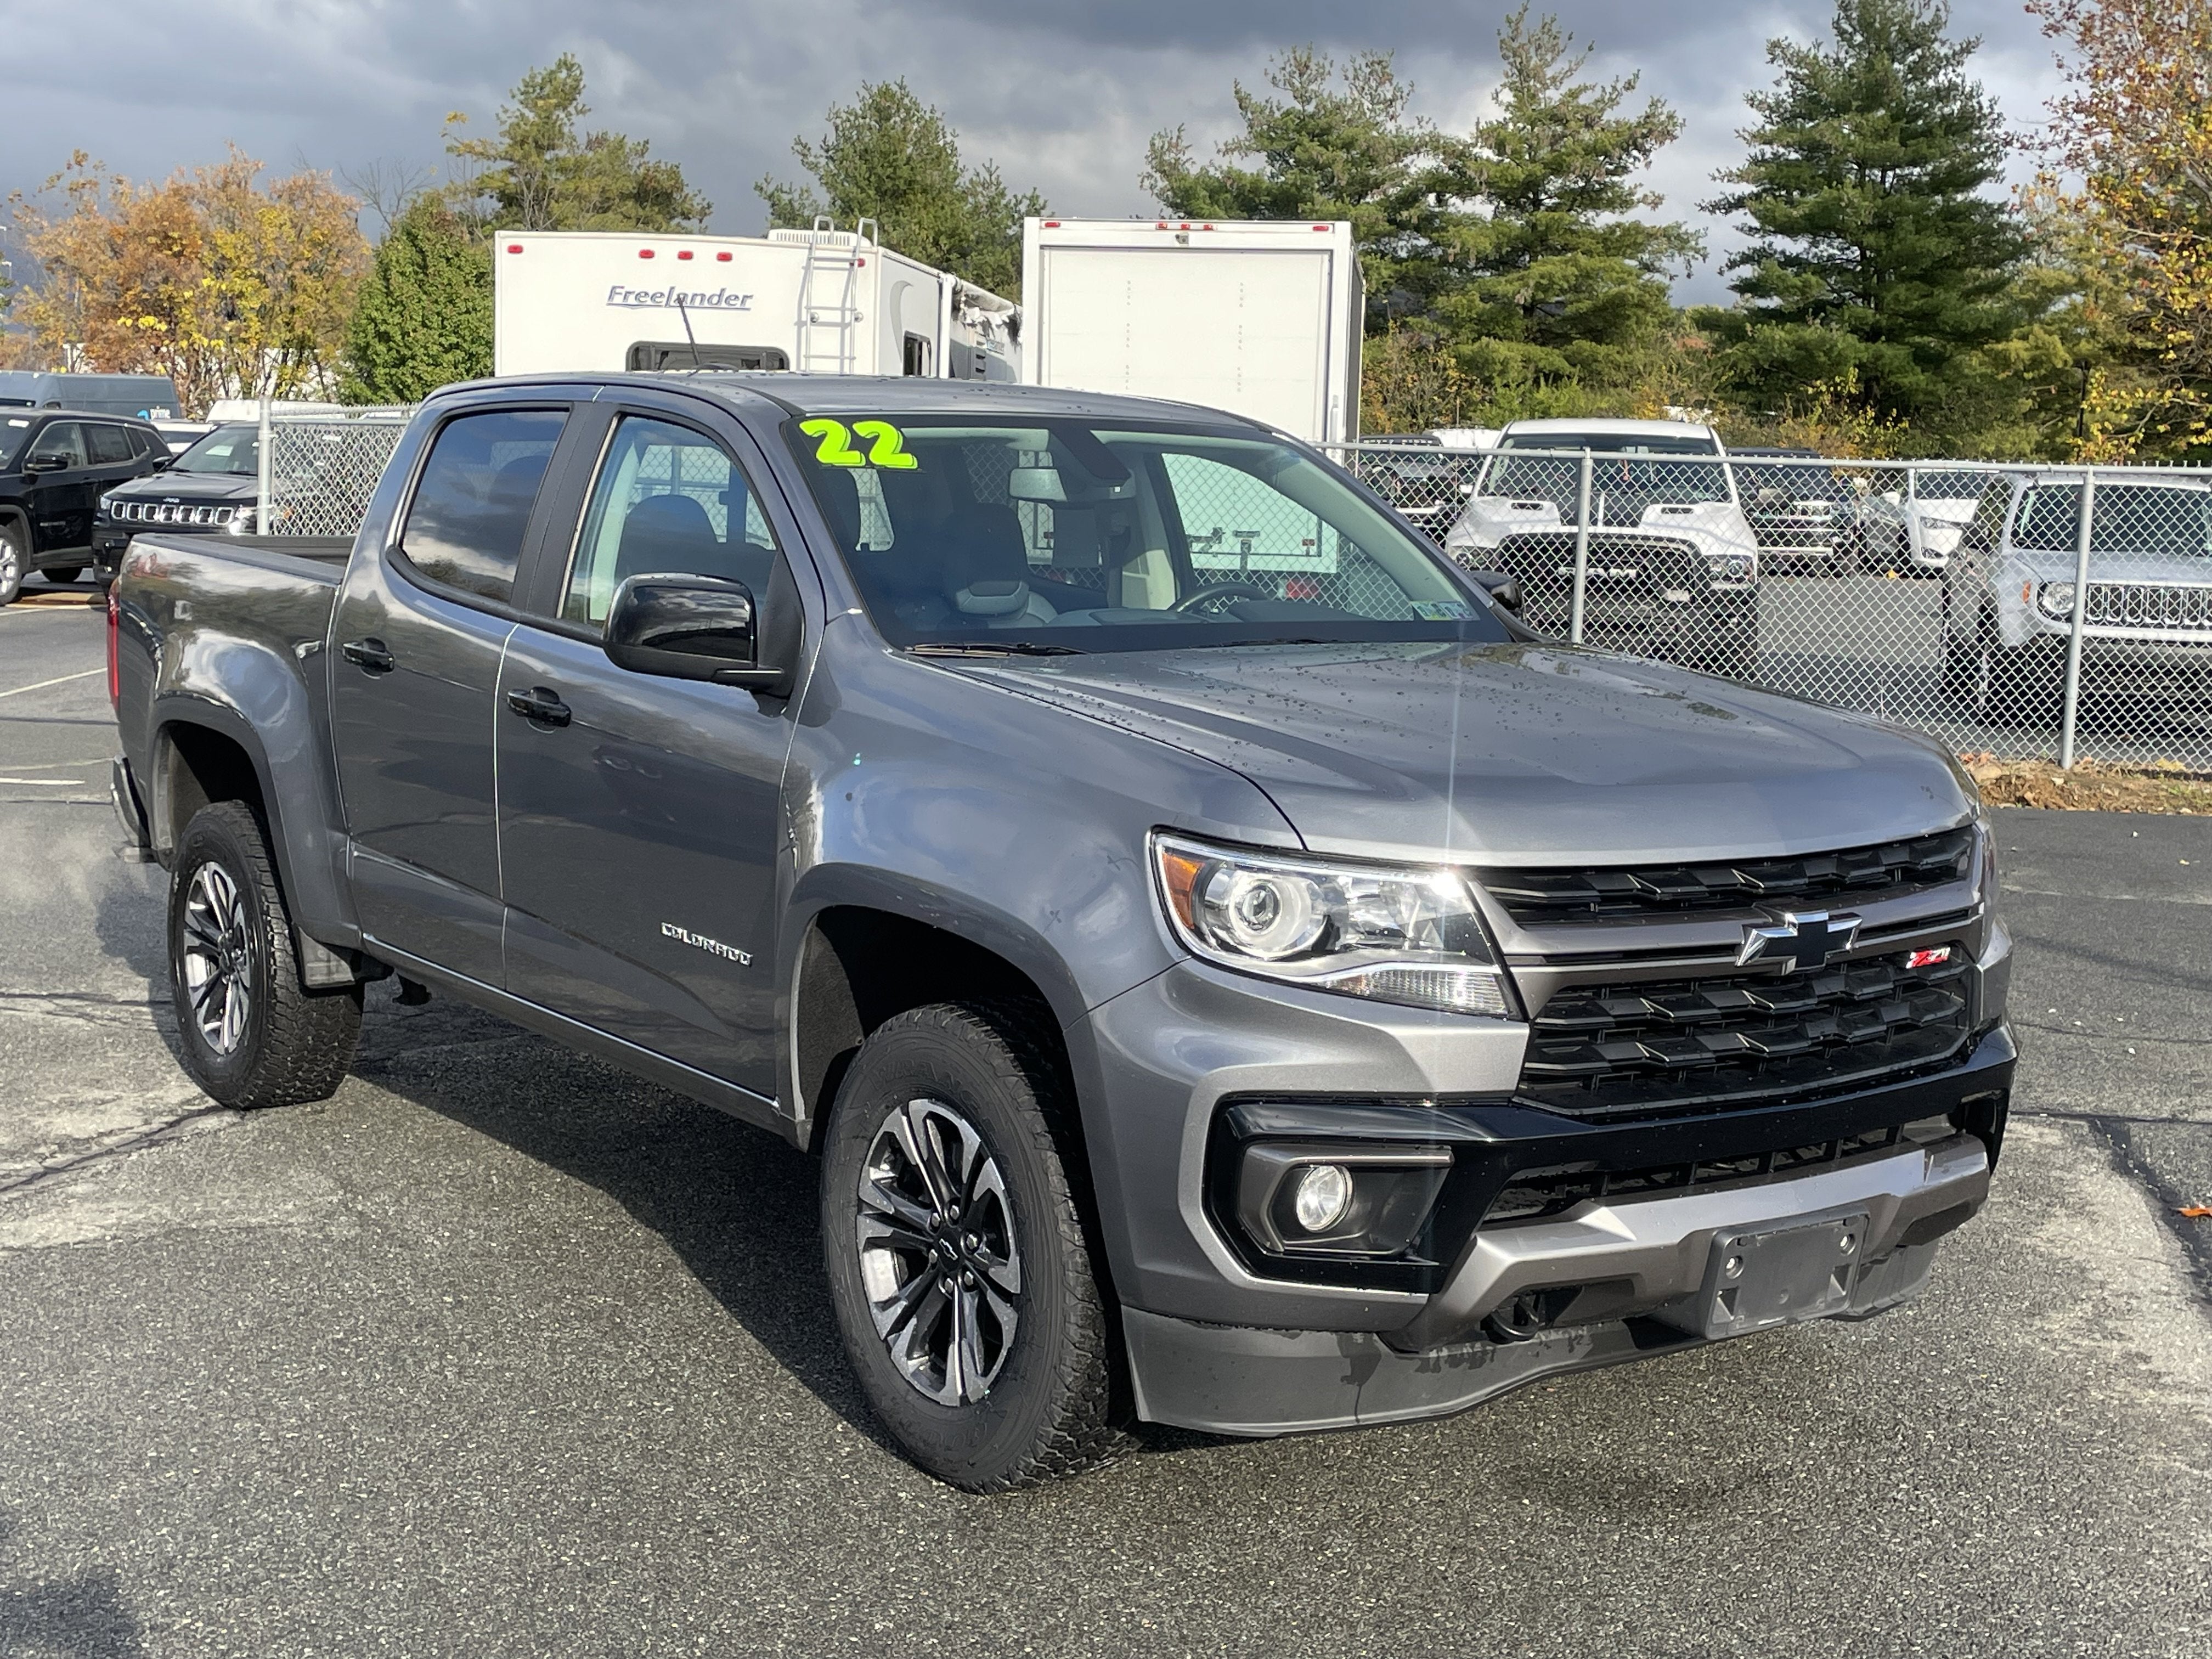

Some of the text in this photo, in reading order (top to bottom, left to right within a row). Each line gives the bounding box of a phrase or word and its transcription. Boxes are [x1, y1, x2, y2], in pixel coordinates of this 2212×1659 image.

[606, 285, 754, 308] Freelander
[799, 419, 918, 469] 22
[661, 922, 753, 966] COLORADO
[1905, 947, 1951, 969] Z71
